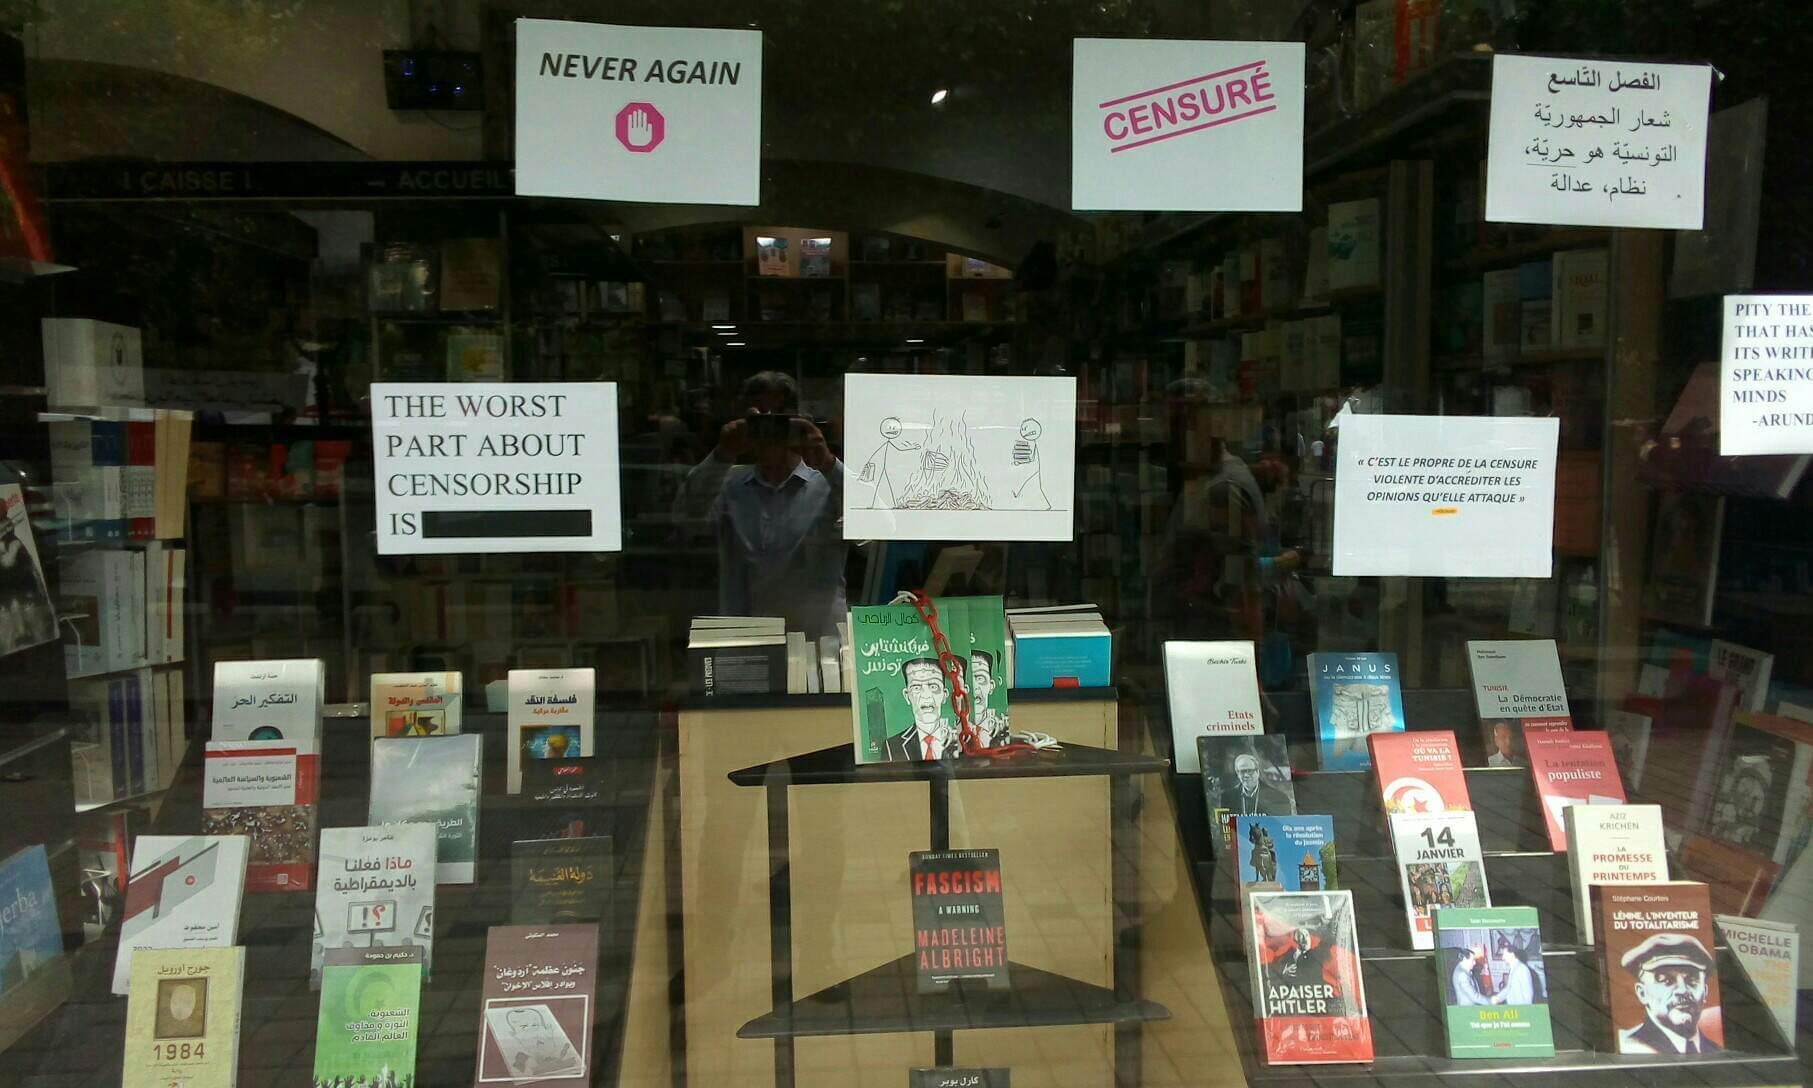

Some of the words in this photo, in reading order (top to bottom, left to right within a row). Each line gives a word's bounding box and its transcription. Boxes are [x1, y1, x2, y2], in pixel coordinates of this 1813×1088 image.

[539, 52, 638, 82] NEVER
[644, 59, 741, 85] AGAIN
[1608, 70, 1661, 93] الفصل
[1103, 66, 1275, 141] CENSURÉ
[1629, 109, 1671, 132] شعار
[1583, 150, 1604, 164] هو
[139, 171, 234, 192] CAISSE
[398, 168, 503, 189] ACCUEIL
[1549, 173, 1593, 193] عدالة
[1735, 303, 1772, 317] PITY
[1778, 303, 1811, 316] THE
[1735, 325, 1780, 338] THAT
[1734, 347, 1760, 360] ITS
[1765, 347, 1813, 360] WRIT
[1732, 368, 1813, 382] SPEAKING
[1733, 390, 1787, 403] MINDS
[385, 395, 447, 418] THE
[455, 395, 567, 418] WORST
[386, 434, 468, 458] PART
[476, 433, 586, 457] ABOUT
[1398, 457, 1411, 467] LE
[1412, 458, 1456, 469] PROPRE
[1457, 458, 1471, 469] DE
[1474, 459, 1488, 469] LA
[1490, 459, 1538, 470] CENSURE
[387, 472, 583, 497] CENSORSHIP
[1373, 474, 1425, 485] VIOLENTE
[1503, 476, 1521, 486] LES
[1366, 491, 1420, 502] OPINIONS
[1467, 493, 1516, 504] ATTAQUE
[389, 512, 417, 536] IS
[1322, 664, 1392, 673] JANUS
[1498, 694, 1509, 703] La
[1513, 693, 1562, 703] Démocratie
[1228, 711, 1254, 720] Etats
[1500, 705, 1511, 713] en
[1206, 721, 1256, 732] criminels
[1548, 767, 1602, 782] populiste
[1609, 812, 1627, 820] AZIZ
[1599, 821, 1640, 831] KRICHEN
[1420, 826, 1456, 849] 14
[1416, 847, 1465, 861] JANVIER
[1592, 853, 1654, 863] PROMESSE
[344, 857, 381, 872] فعلنا
[386, 856, 412, 871] ماذا
[914, 869, 1001, 896] FASCISM
[1592, 872, 1657, 881] PRINTEMPS
[333, 874, 417, 895] بالديمقراطية
[938, 905, 944, 915] A
[946, 904, 980, 915] WARNING
[1613, 920, 1628, 931] DU
[1631, 920, 1700, 931] TOTALITARISME
[917, 926, 1005, 947] MADELEINE
[1721, 929, 1792, 948] MICHELLE
[919, 947, 1007, 969] ALBRIGHT
[1738, 943, 1792, 961] OBAMA
[1268, 984, 1334, 999] APAISER
[1269, 999, 1327, 1014] HITLER
[153, 1042, 206, 1061] 1984
